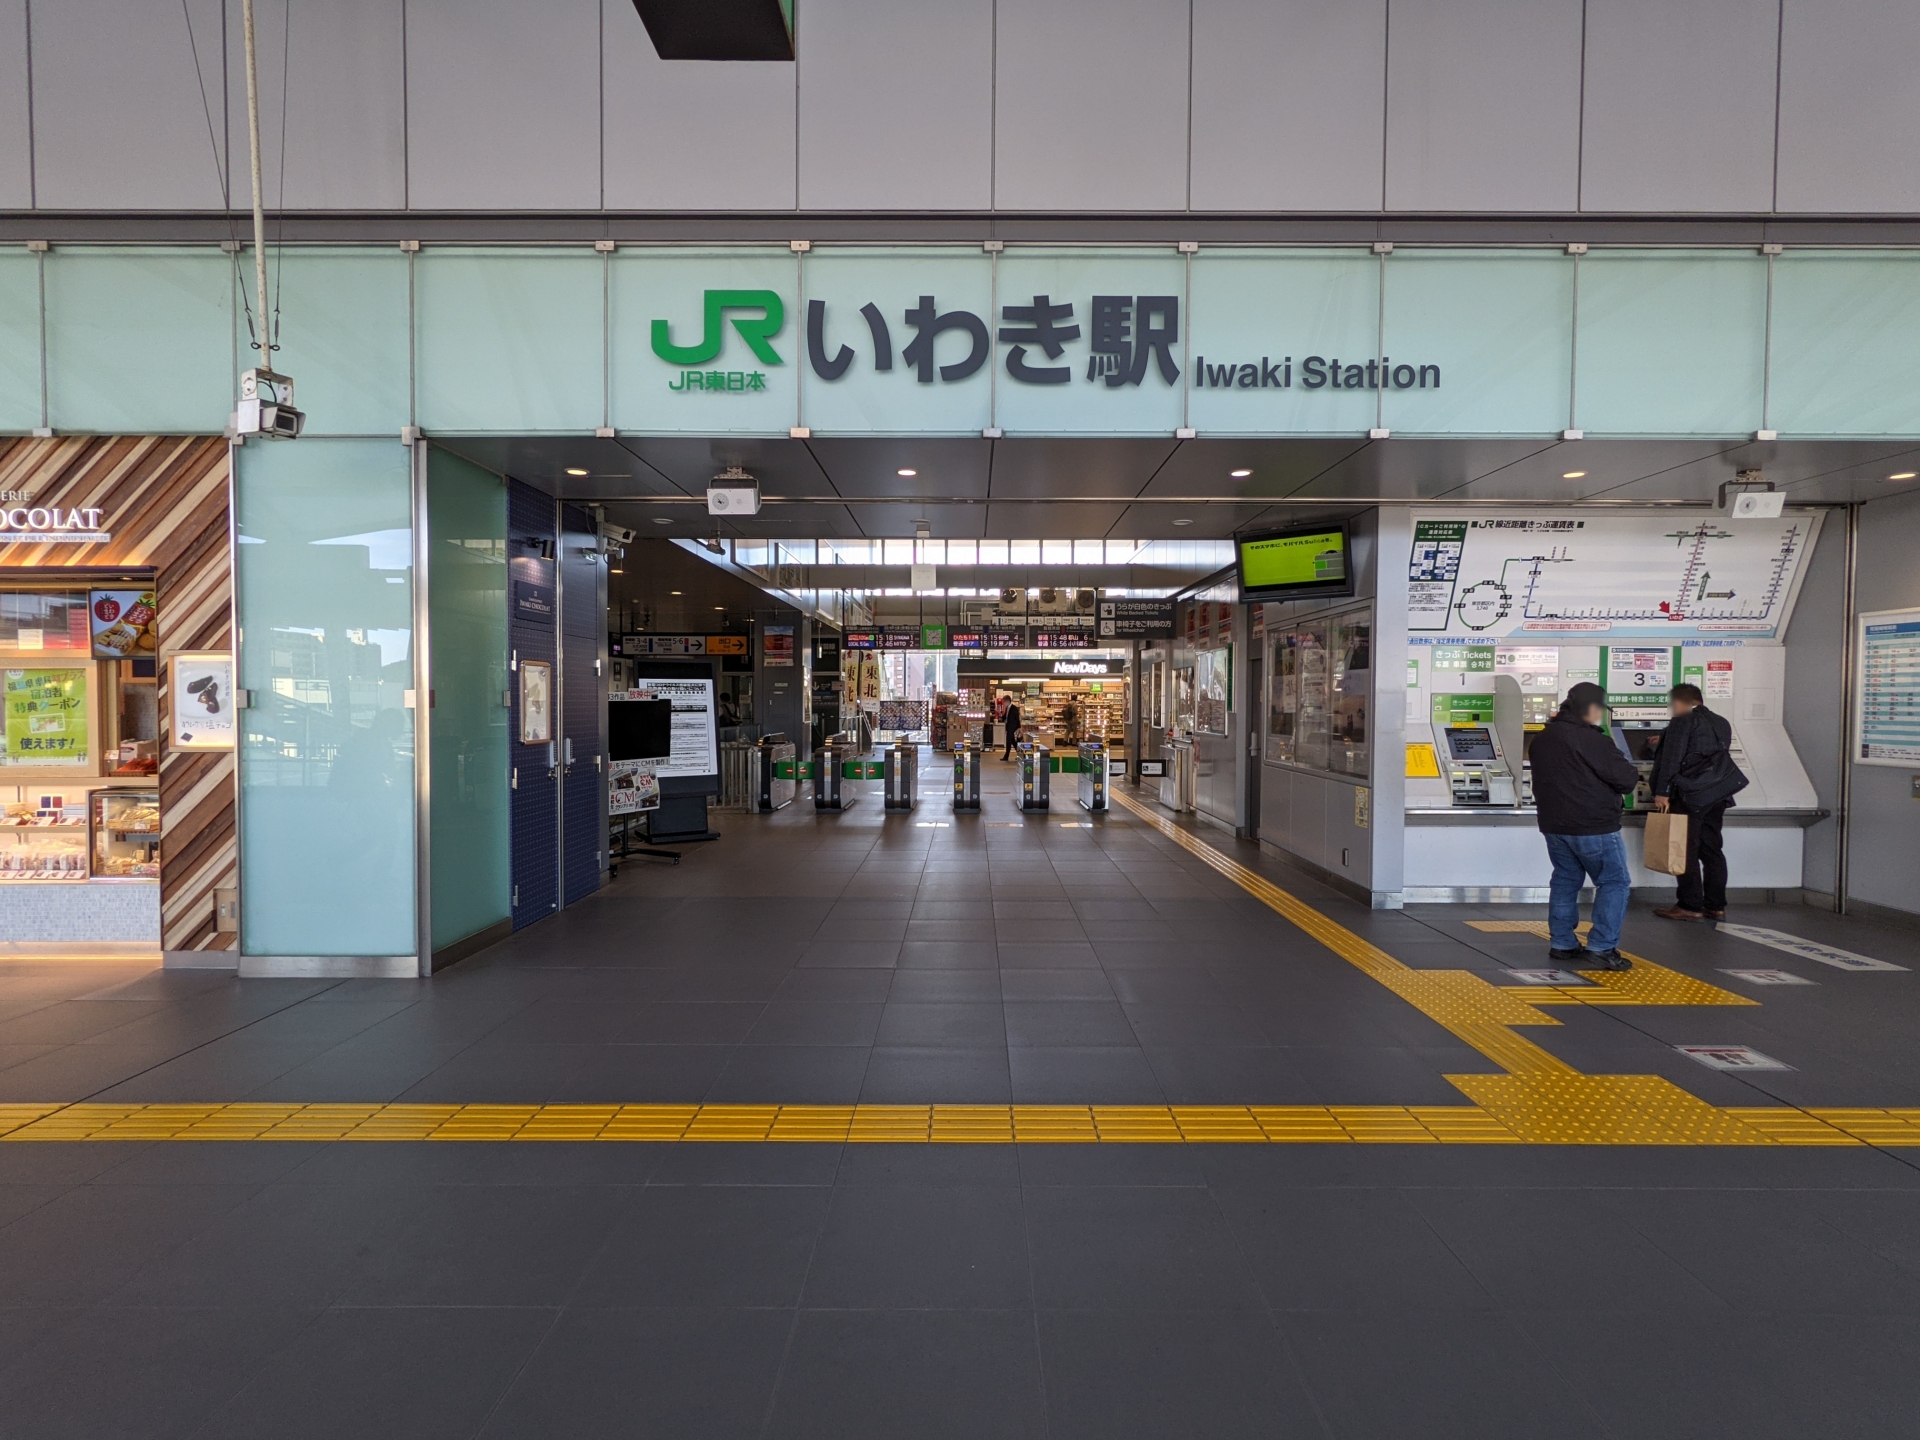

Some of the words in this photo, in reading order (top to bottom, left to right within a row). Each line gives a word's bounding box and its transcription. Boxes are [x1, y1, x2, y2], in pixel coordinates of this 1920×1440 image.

[651, 290, 784, 364] JR
[807, 295, 1180, 389] いわき駅
[1196, 356, 1291, 388] Iwaki
[1302, 356, 1440, 389] Station
[669, 370, 766, 391] JR東日本
[1054, 662, 1107, 674] NewDays
[864, 664, 878, 698] 東北
[1459, 673, 1465, 685] 1
[1521, 673, 1532, 686] 2
[1634, 673, 1645, 686] 3
[31, 688, 62, 700] 宿泊者
[629, 690, 651, 700] 放映中
[15, 698, 80, 714] 特典クーポン
[20, 738, 76, 751] 使えます!
[615, 791, 635, 804] CM
